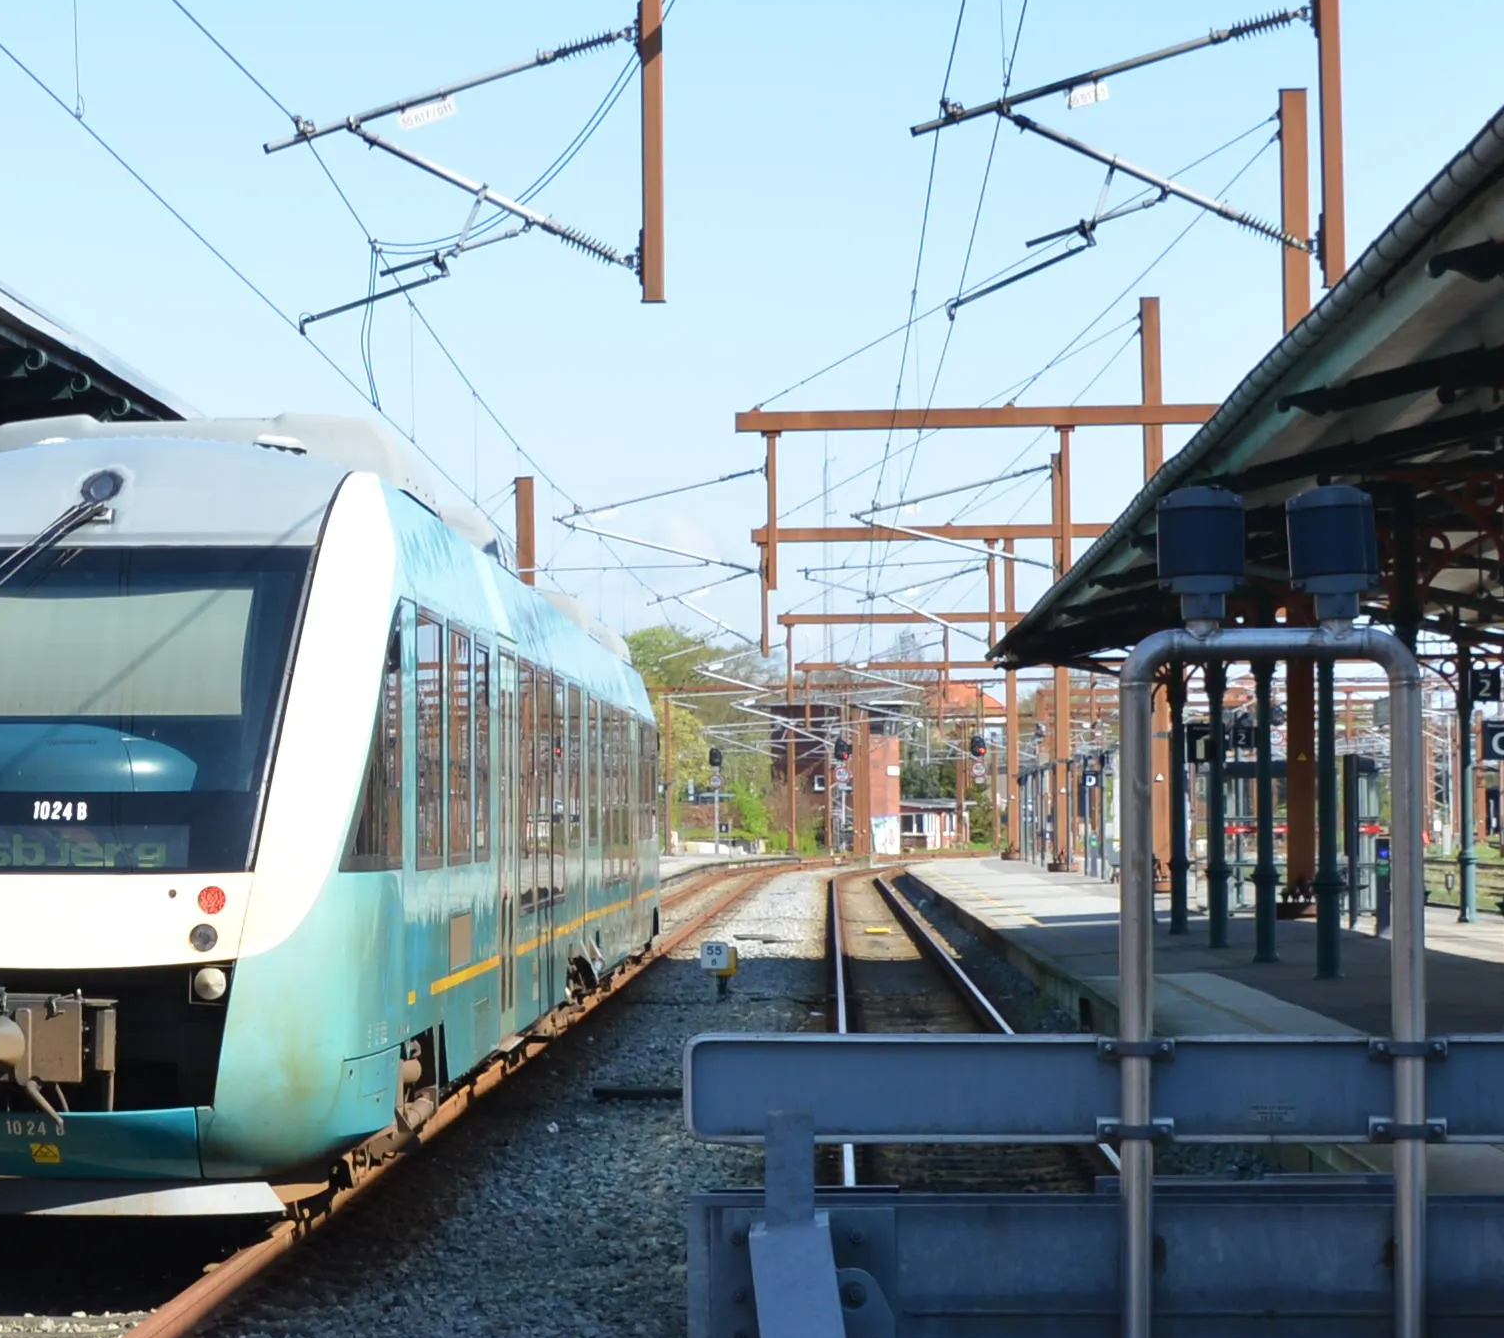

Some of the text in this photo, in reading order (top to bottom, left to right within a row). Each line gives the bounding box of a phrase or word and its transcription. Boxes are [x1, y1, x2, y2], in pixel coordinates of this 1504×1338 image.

[1478, 678, 1492, 697] 2
[33, 801, 87, 821] 1024 B
[707, 945, 722, 955] 55
